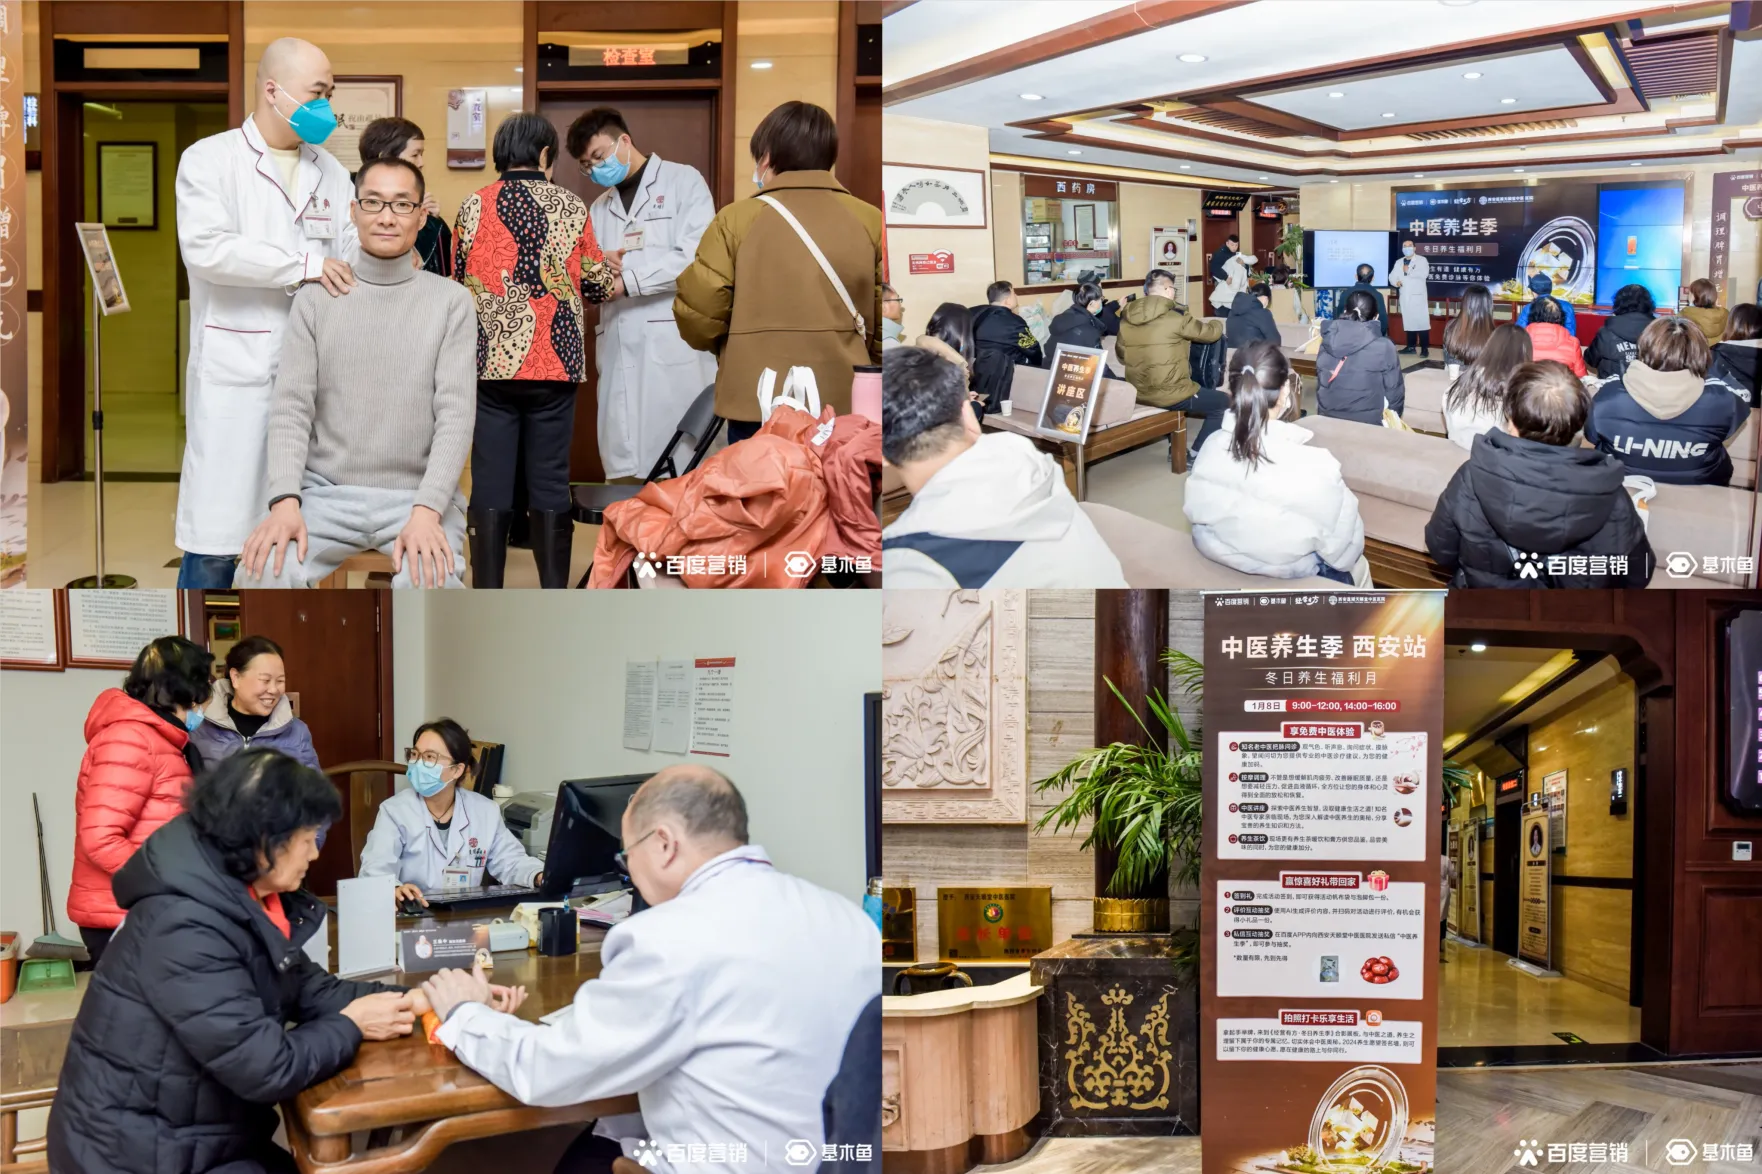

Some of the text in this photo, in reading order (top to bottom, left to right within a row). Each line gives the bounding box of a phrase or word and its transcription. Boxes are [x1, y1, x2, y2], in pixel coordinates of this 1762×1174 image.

[603, 47, 656, 66] 检查室
[1056, 181, 1095, 194] 西药房
[1409, 217, 1498, 237] 中医养生季
[1423, 245, 1482, 254] 冬日养生福利月
[1056, 383, 1086, 399] 讲座区
[1613, 435, 1709, 459] LI-NING
[1221, 634, 1427, 660] 中医养生季 西安站
[1265, 671, 1377, 686] 冬日养生福利月
[1252, 701, 1281, 711] 1月8日
[1290, 726, 1355, 737] 享免费中医体验
[1285, 877, 1357, 887] 赢惊喜好礼带回家
[1284, 1013, 1355, 1024] 拍照打卡乐享生活
